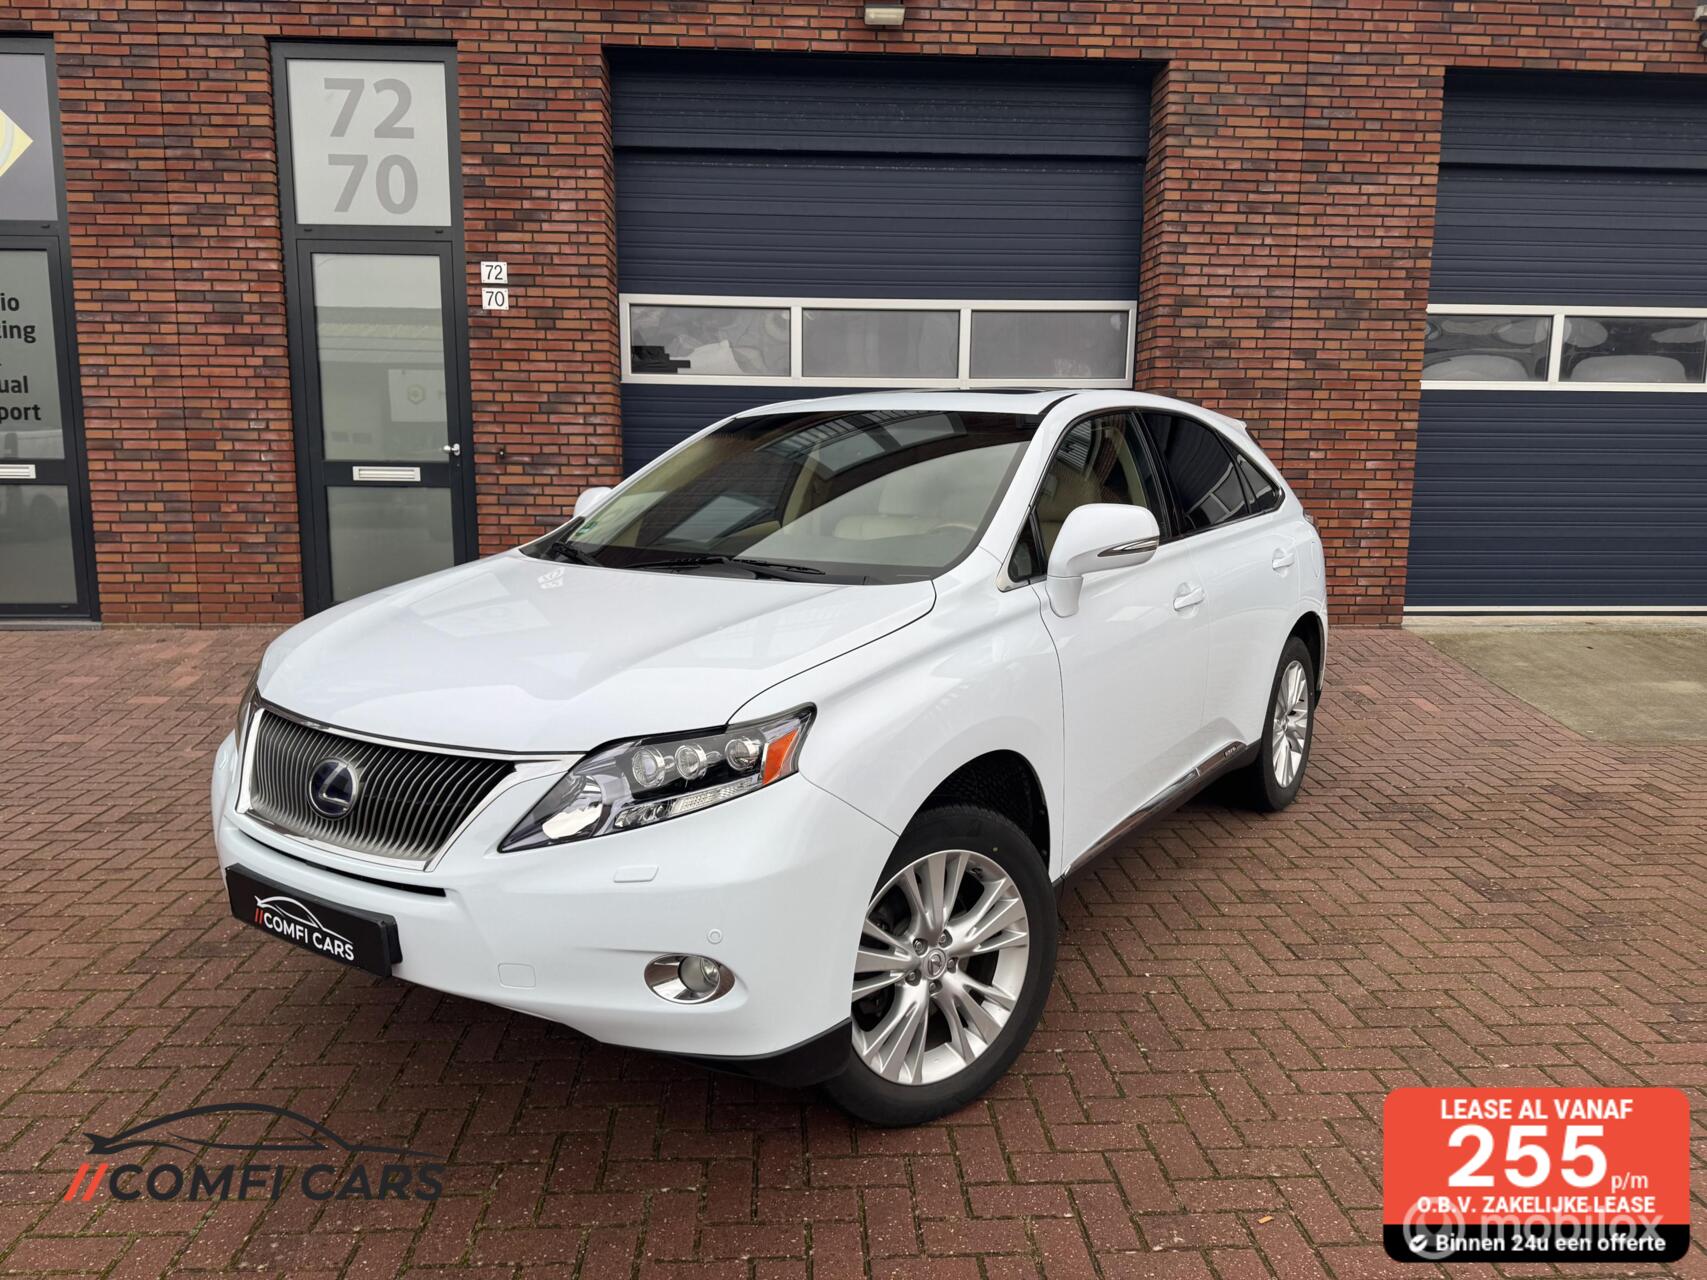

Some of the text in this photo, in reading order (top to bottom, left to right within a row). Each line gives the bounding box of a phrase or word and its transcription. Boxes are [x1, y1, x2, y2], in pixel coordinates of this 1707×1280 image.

[323, 77, 415, 139] 72
[327, 153, 418, 215] 70
[485, 264, 504, 280] 72
[485, 290, 505, 307] 70
[0, 320, 36, 344] ing
[263, 912, 355, 961] COMFI CARS
